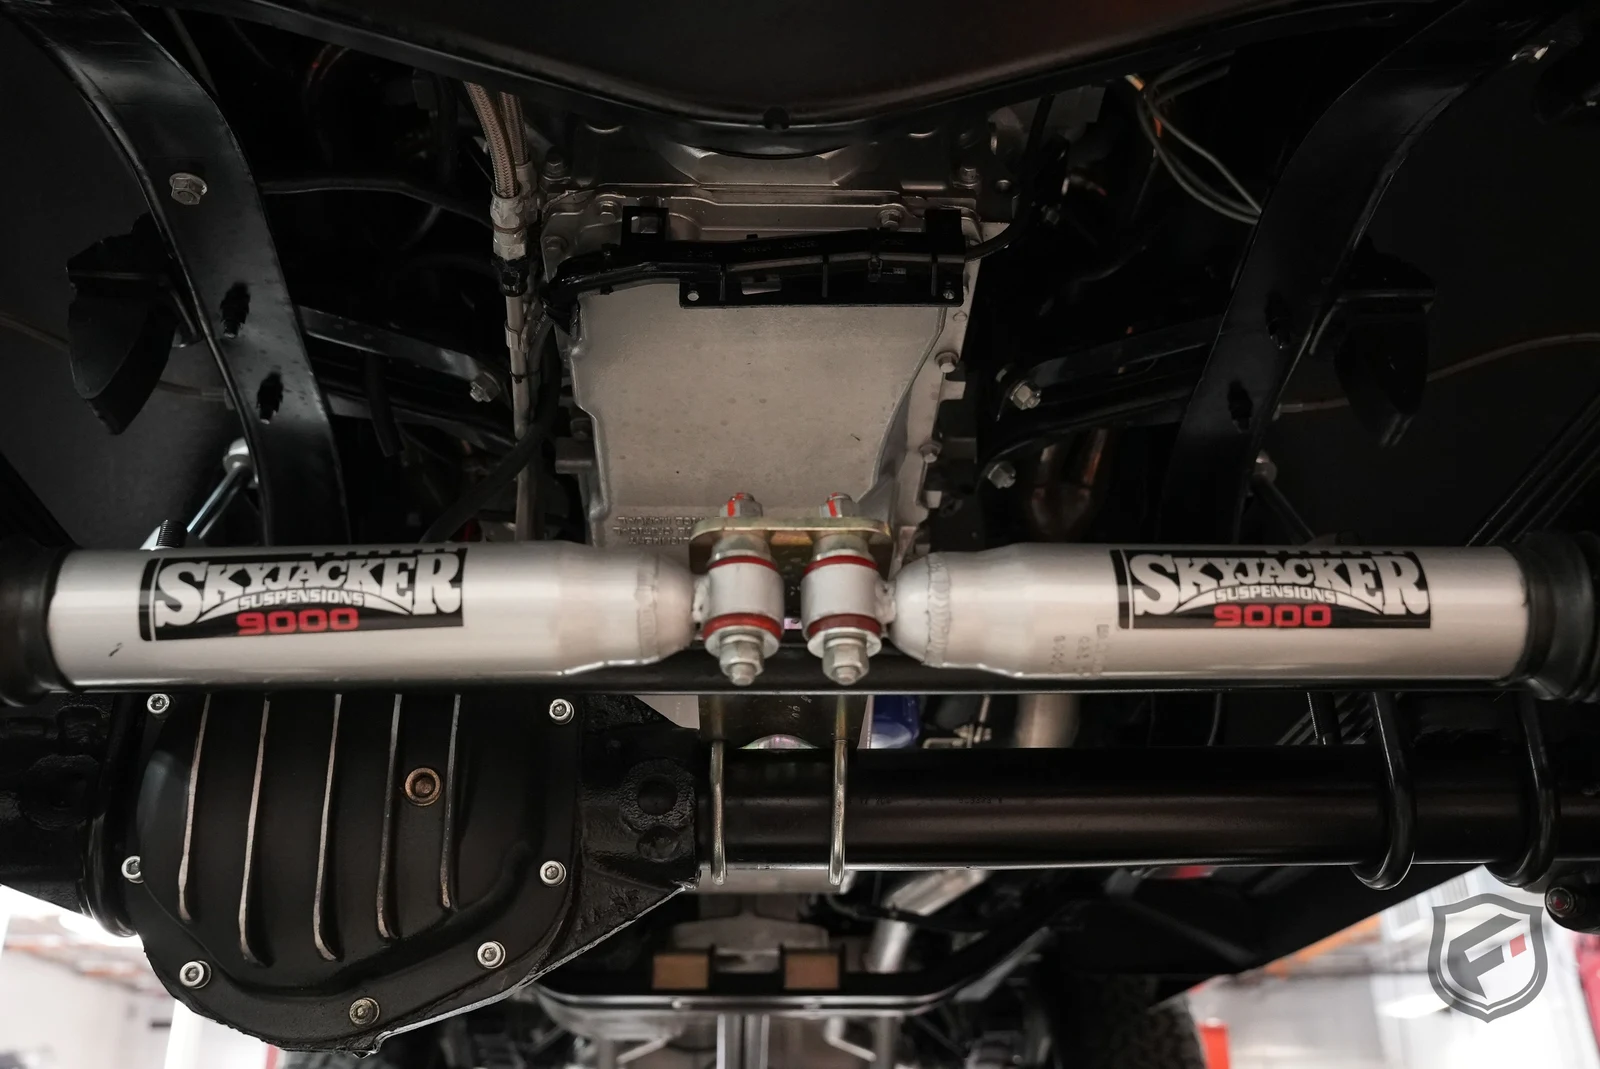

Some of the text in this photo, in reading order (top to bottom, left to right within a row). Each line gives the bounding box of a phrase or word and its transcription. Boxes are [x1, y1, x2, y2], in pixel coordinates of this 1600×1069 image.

[157, 553, 463, 627] SKYJACKER
[1128, 553, 1430, 616] SKYJACKER
[1214, 584, 1337, 604] SUSPENSIONS
[238, 588, 365, 608] SUSPENSIONS
[236, 607, 360, 635] 9000
[1213, 604, 1332, 628] 9000
